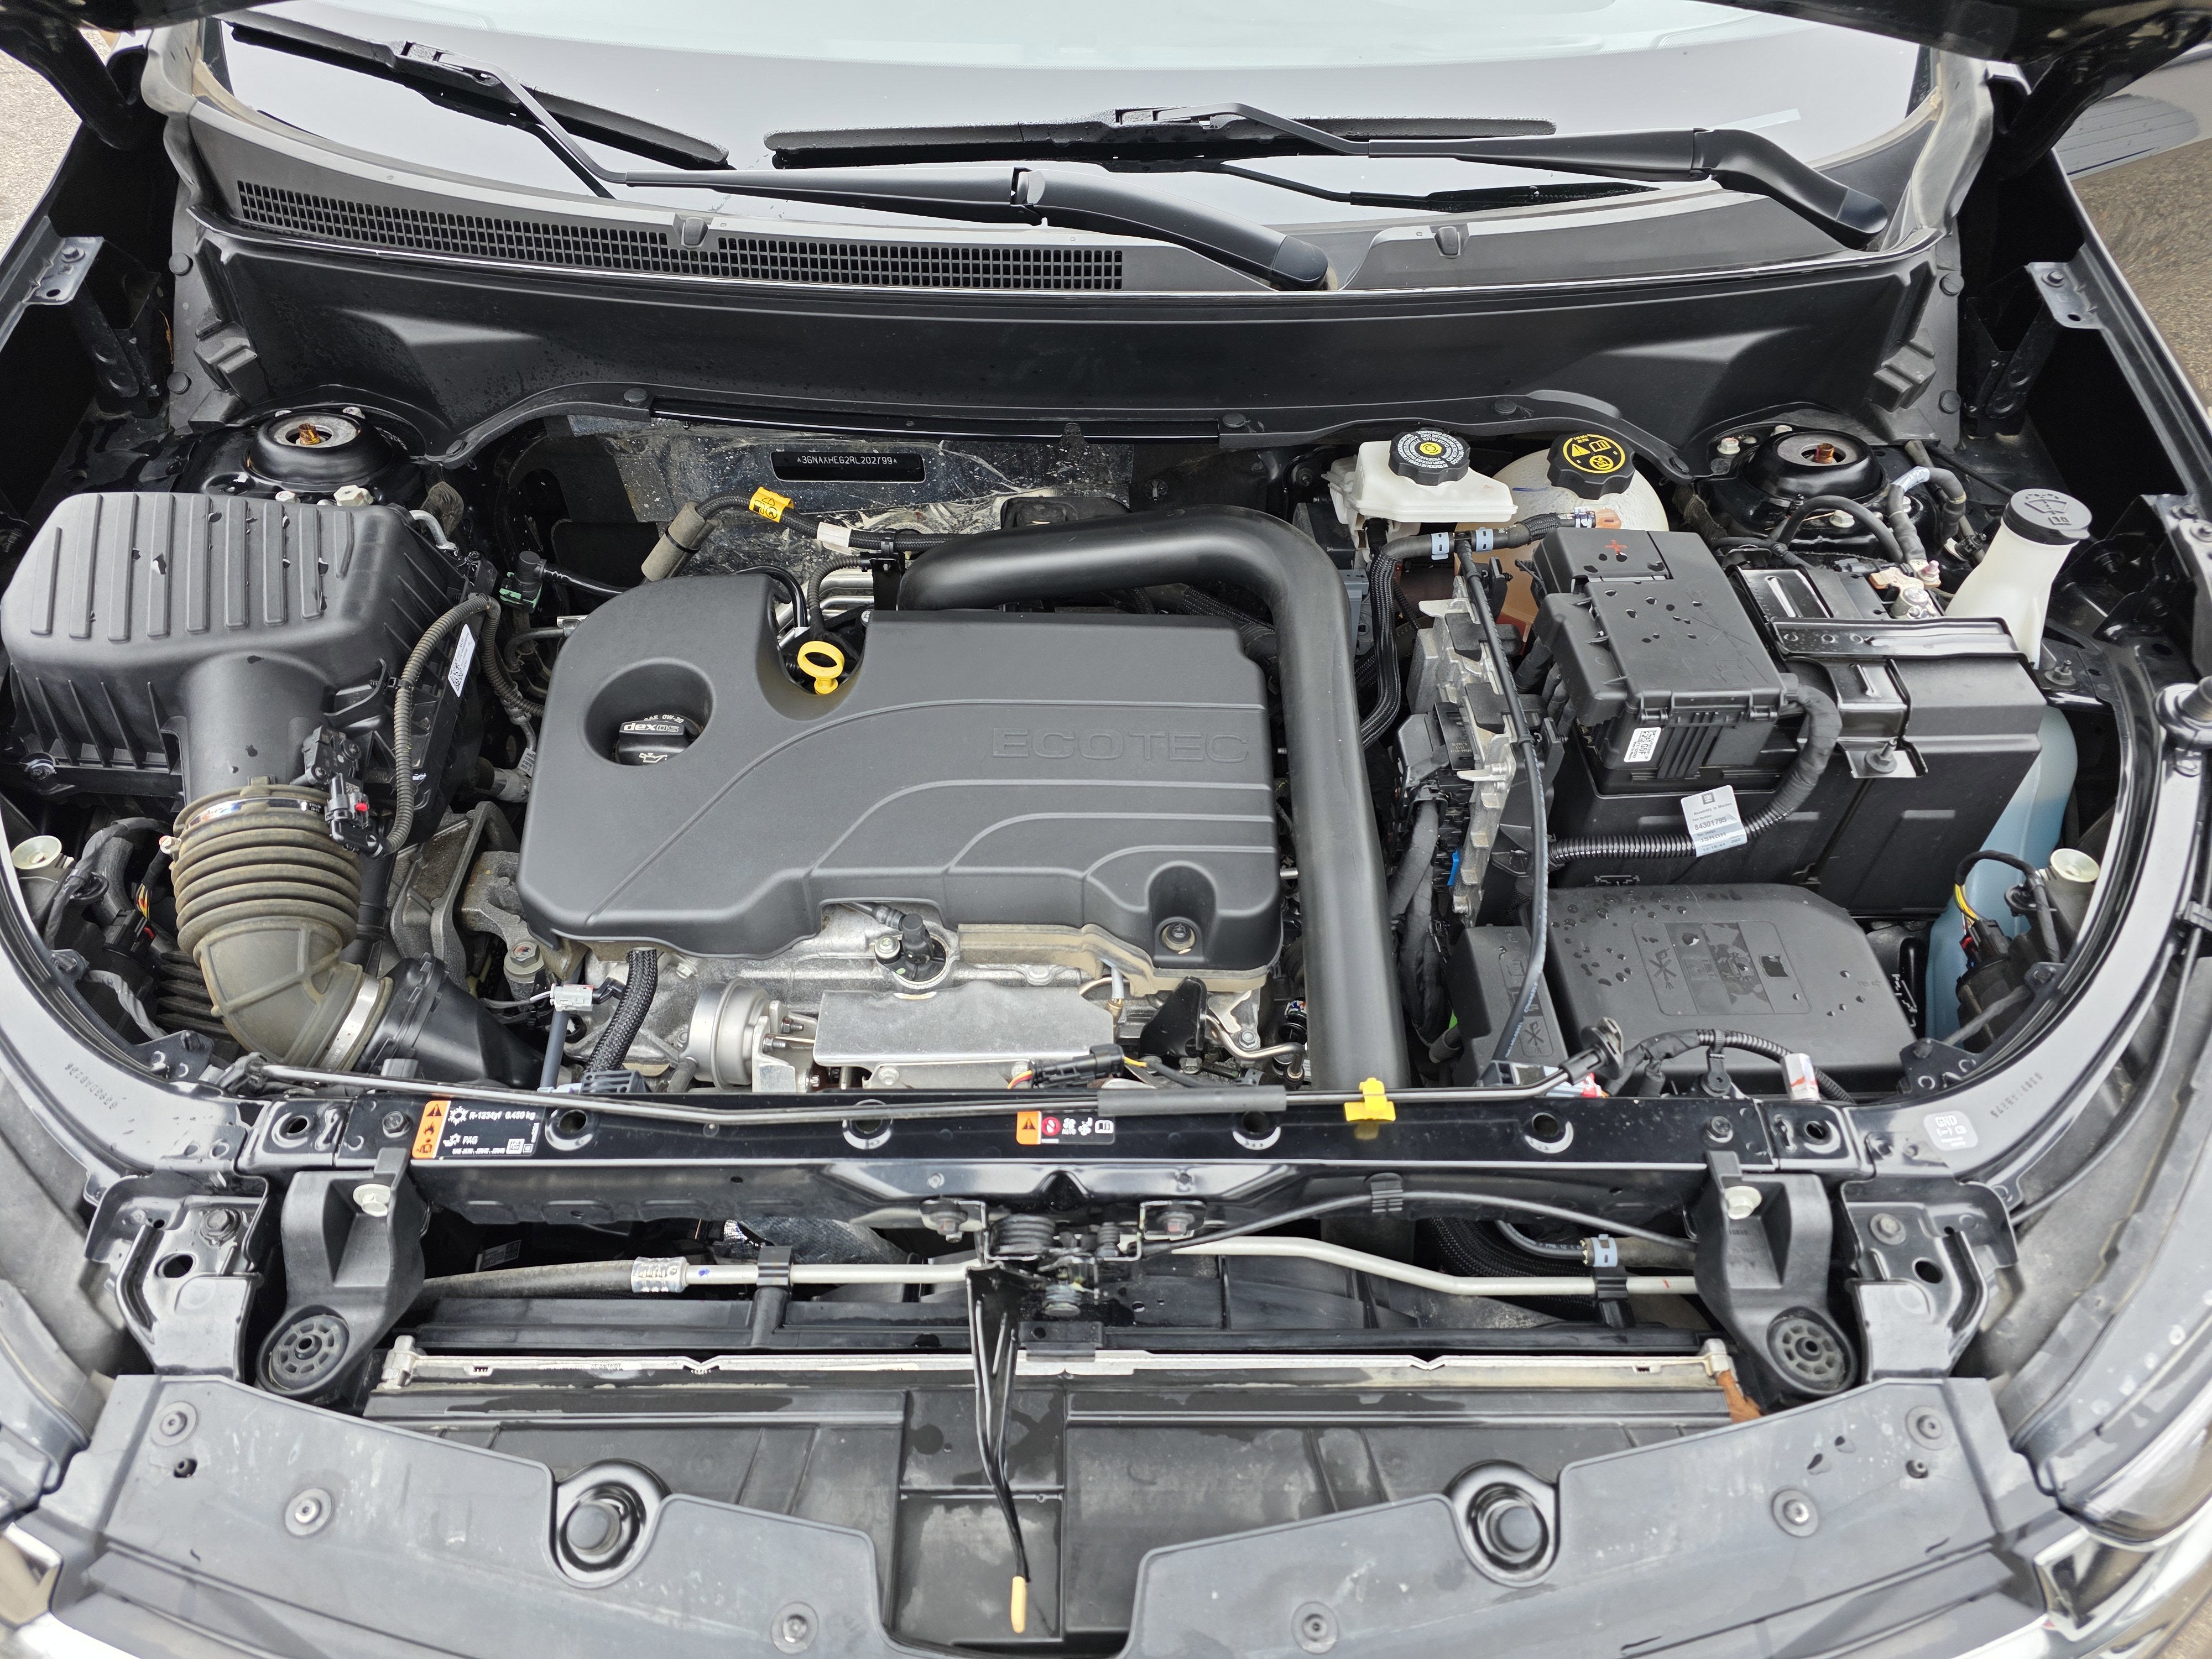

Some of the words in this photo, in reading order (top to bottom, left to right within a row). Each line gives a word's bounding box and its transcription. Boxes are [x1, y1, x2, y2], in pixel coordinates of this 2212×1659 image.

[662, 714, 685, 724] 0W-20
[623, 722, 680, 733] dexos
[992, 727, 1249, 763] ECOTEC
[1694, 816, 1727, 831] 84301795
[469, 1110, 502, 1121] R-1234yf
[505, 1110, 525, 1120] 0.450
[525, 1111, 536, 1120] kg
[1934, 1114, 1958, 1128] GND
[462, 1135, 478, 1145] PAG
